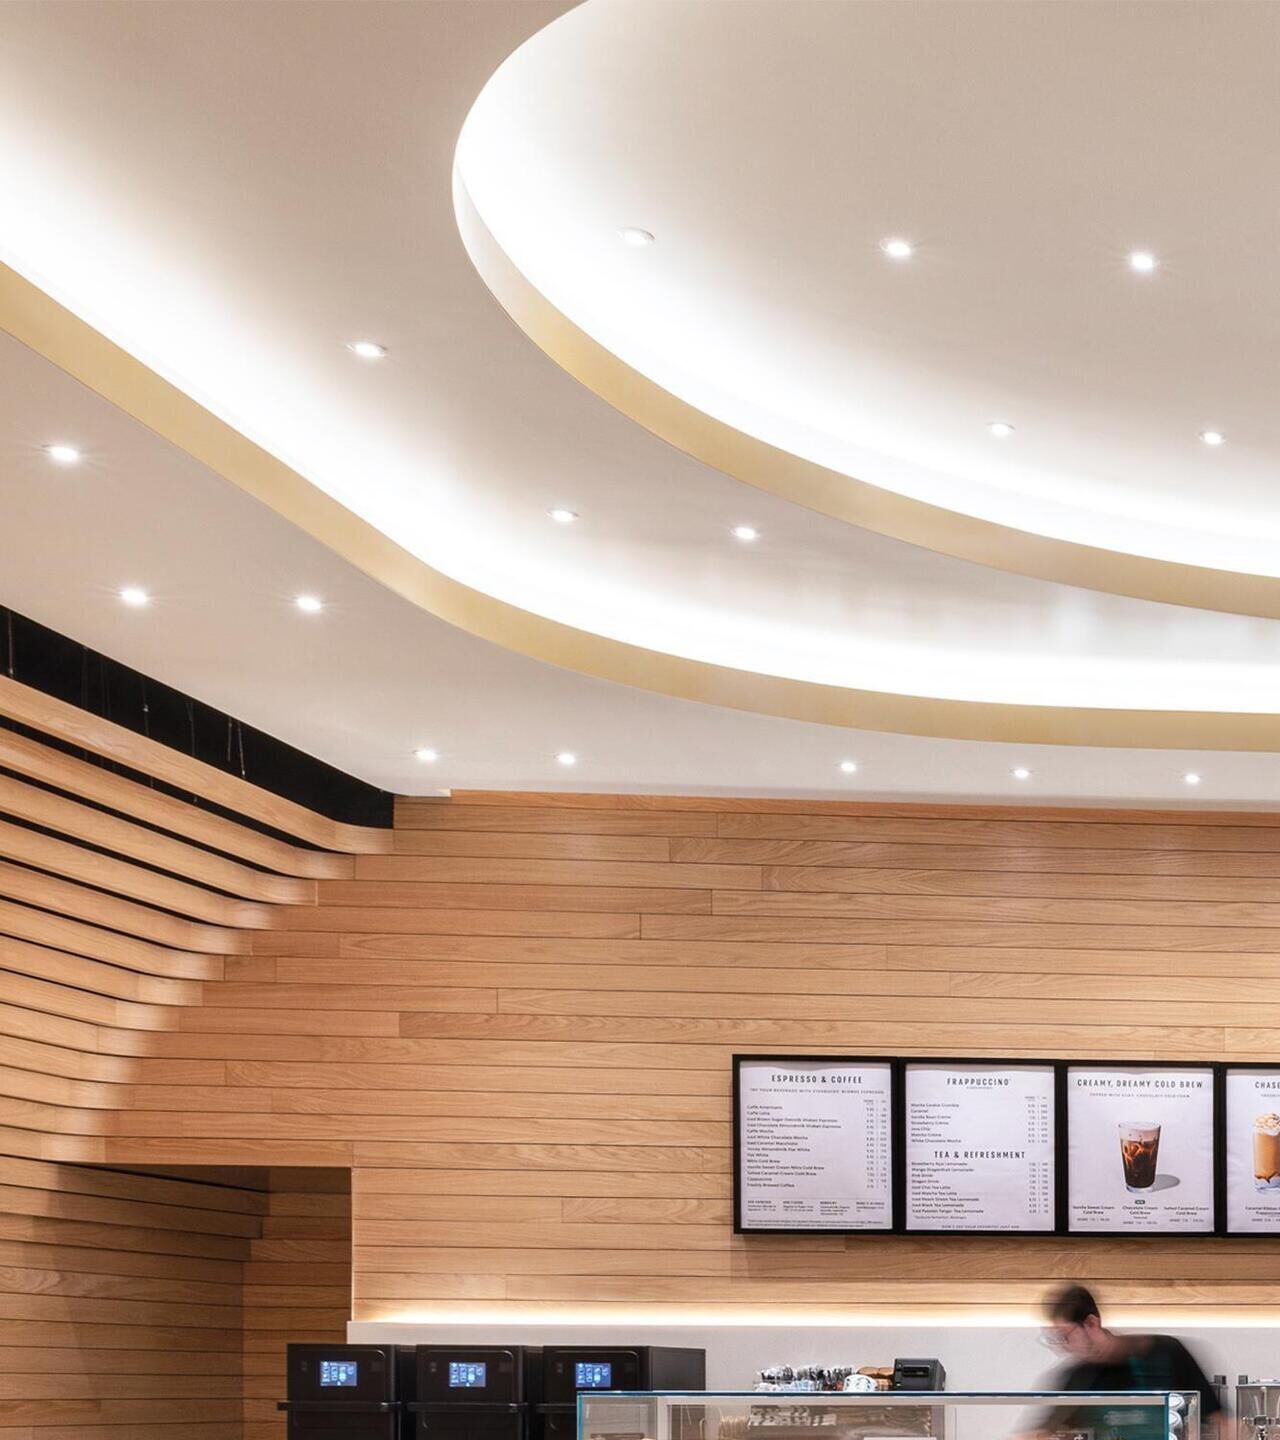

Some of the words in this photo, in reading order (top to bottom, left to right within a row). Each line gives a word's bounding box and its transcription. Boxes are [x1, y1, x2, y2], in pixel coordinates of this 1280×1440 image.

[771, 1074, 817, 1083] ESPRESSO
[831, 1076, 862, 1084] COFFEE
[947, 1078, 1009, 1086] FRAPPUCCINO
[1077, 1079, 1113, 1088] CREAMY,
[1116, 1080, 1150, 1088] DREAMY
